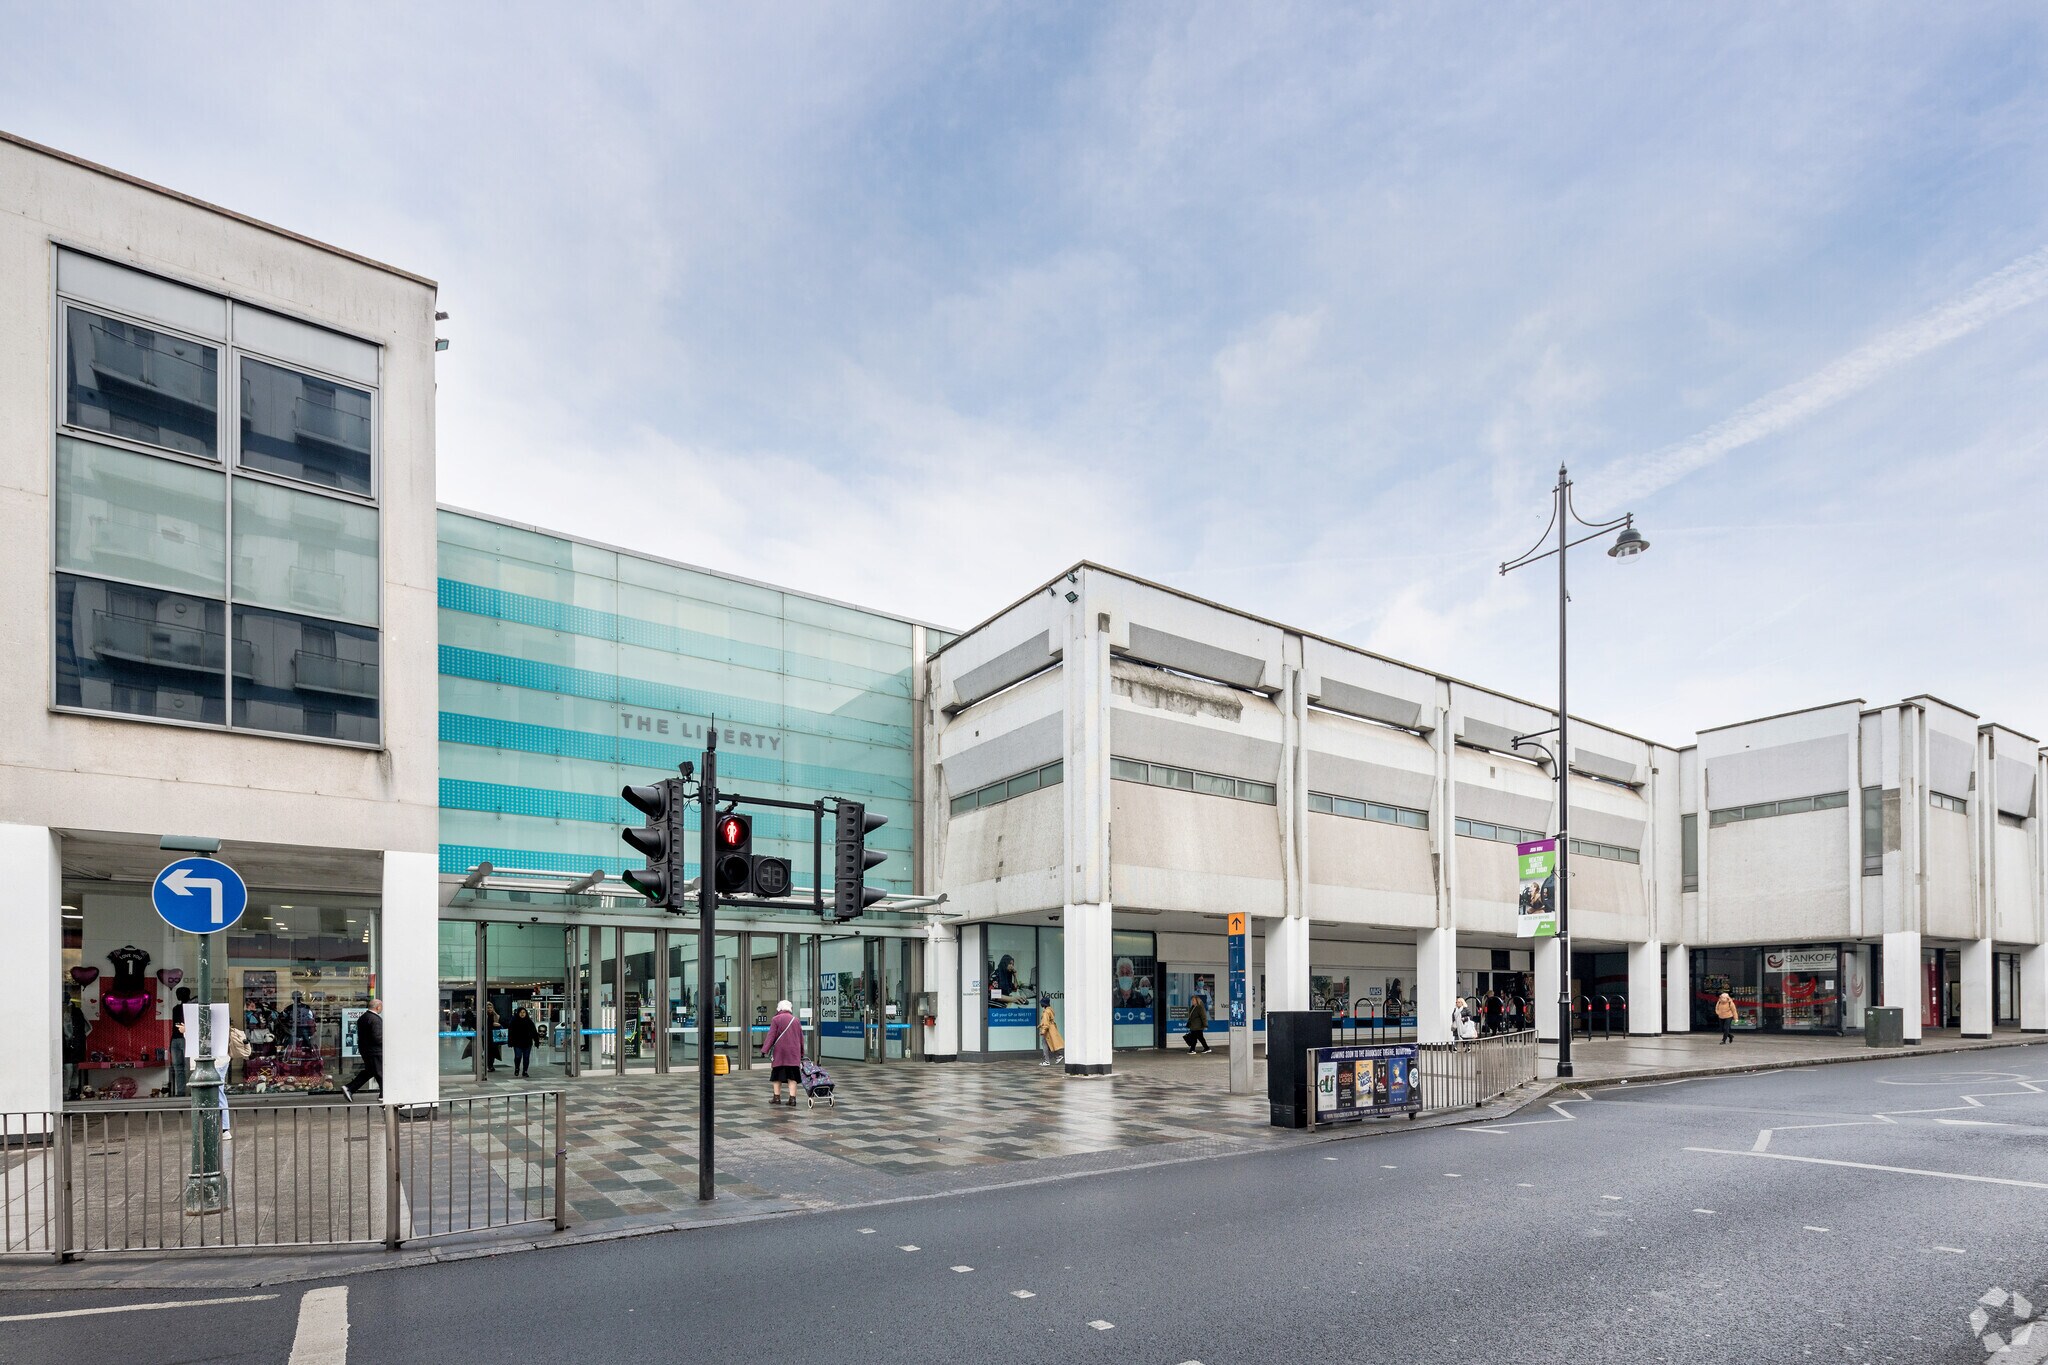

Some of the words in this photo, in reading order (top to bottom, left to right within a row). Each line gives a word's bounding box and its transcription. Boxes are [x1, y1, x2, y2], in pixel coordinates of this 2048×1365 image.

[621, 713, 669, 735] THE
[132, 953, 143, 961] YOU
[1785, 953, 1837, 963] SANKOFA
[127, 960, 133, 975] 1
[821, 974, 836, 989] NHS
[821, 996, 836, 1006] VID-19
[1319, 1074, 1335, 1093] elf
